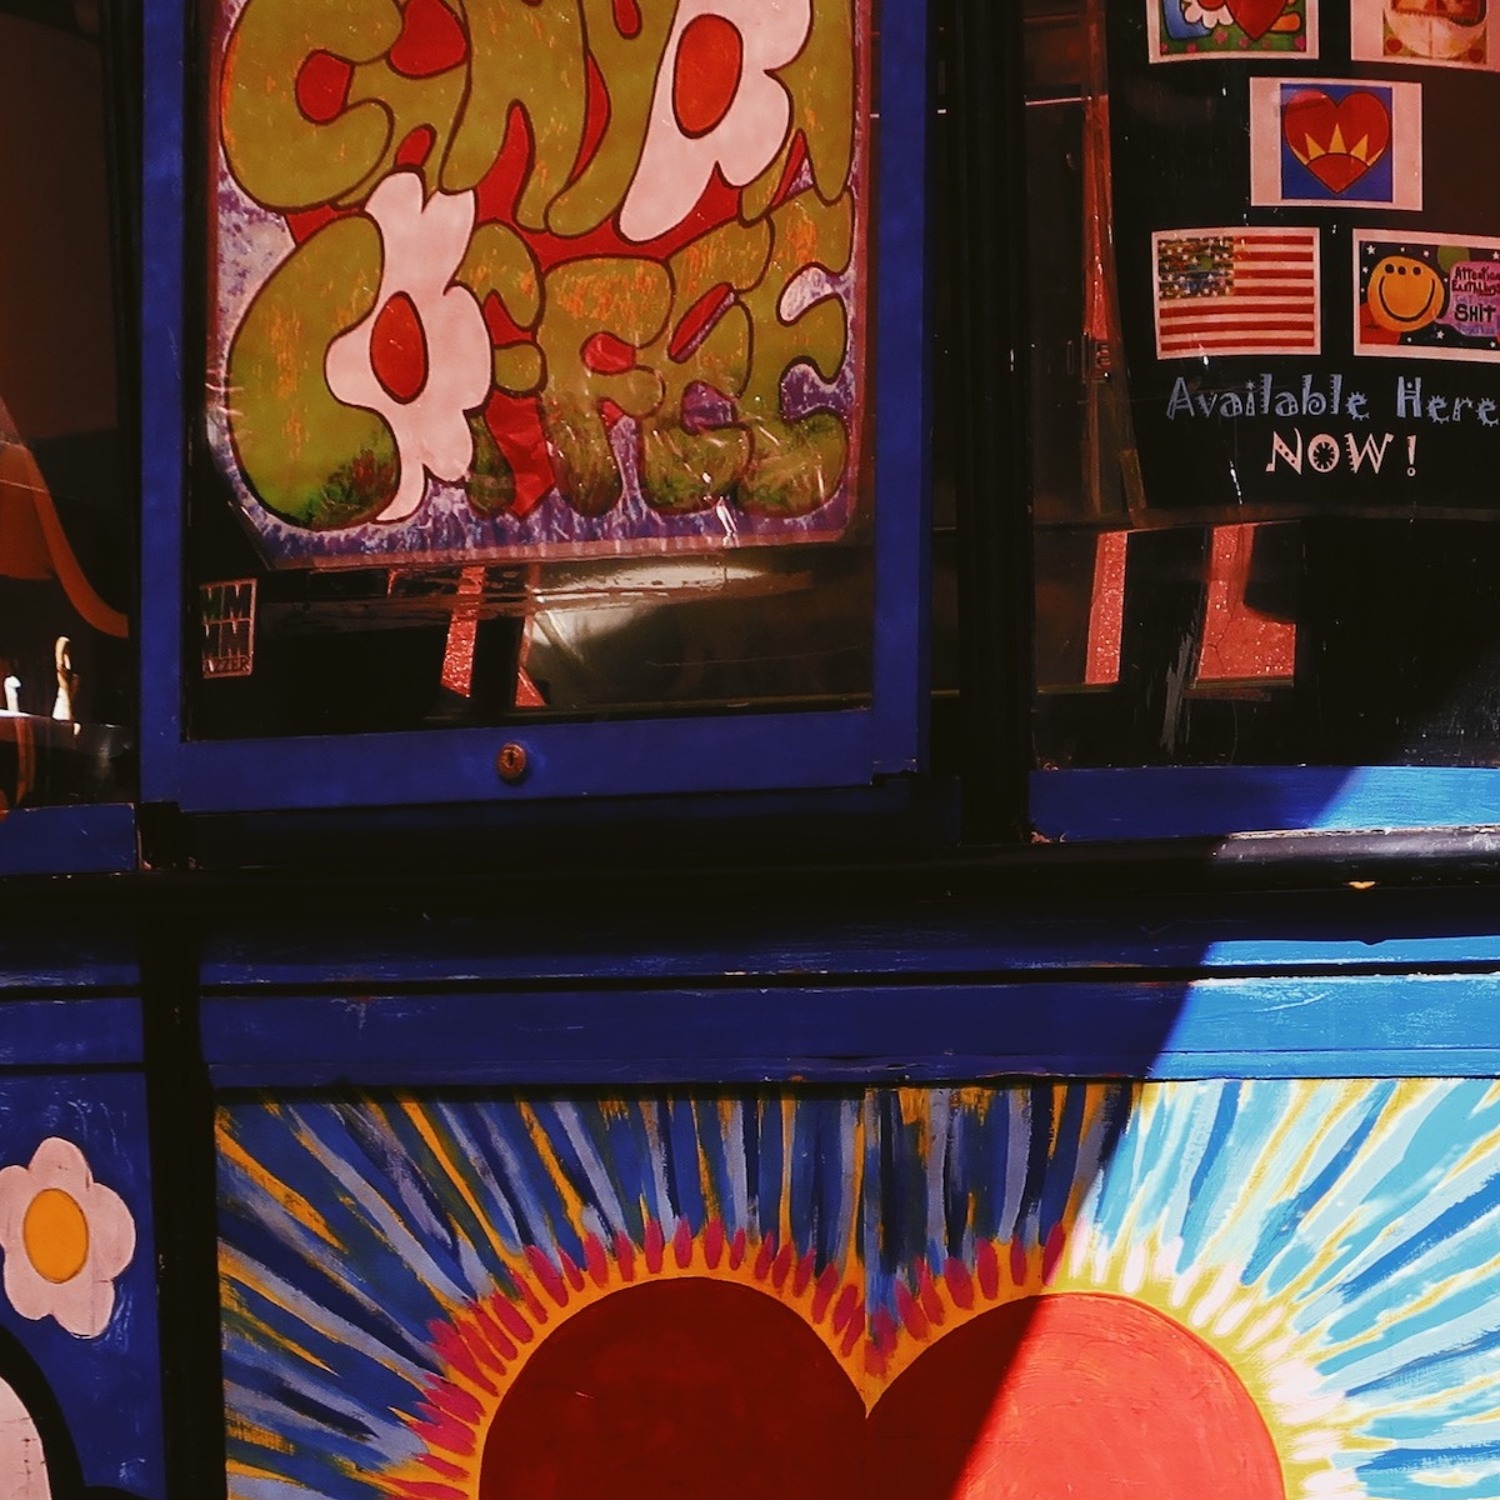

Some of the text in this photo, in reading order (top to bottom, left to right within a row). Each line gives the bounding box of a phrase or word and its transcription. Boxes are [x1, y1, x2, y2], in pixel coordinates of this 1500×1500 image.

[1454, 303, 1497, 322] SHIT
[1166, 373, 1500, 428] Available Here
